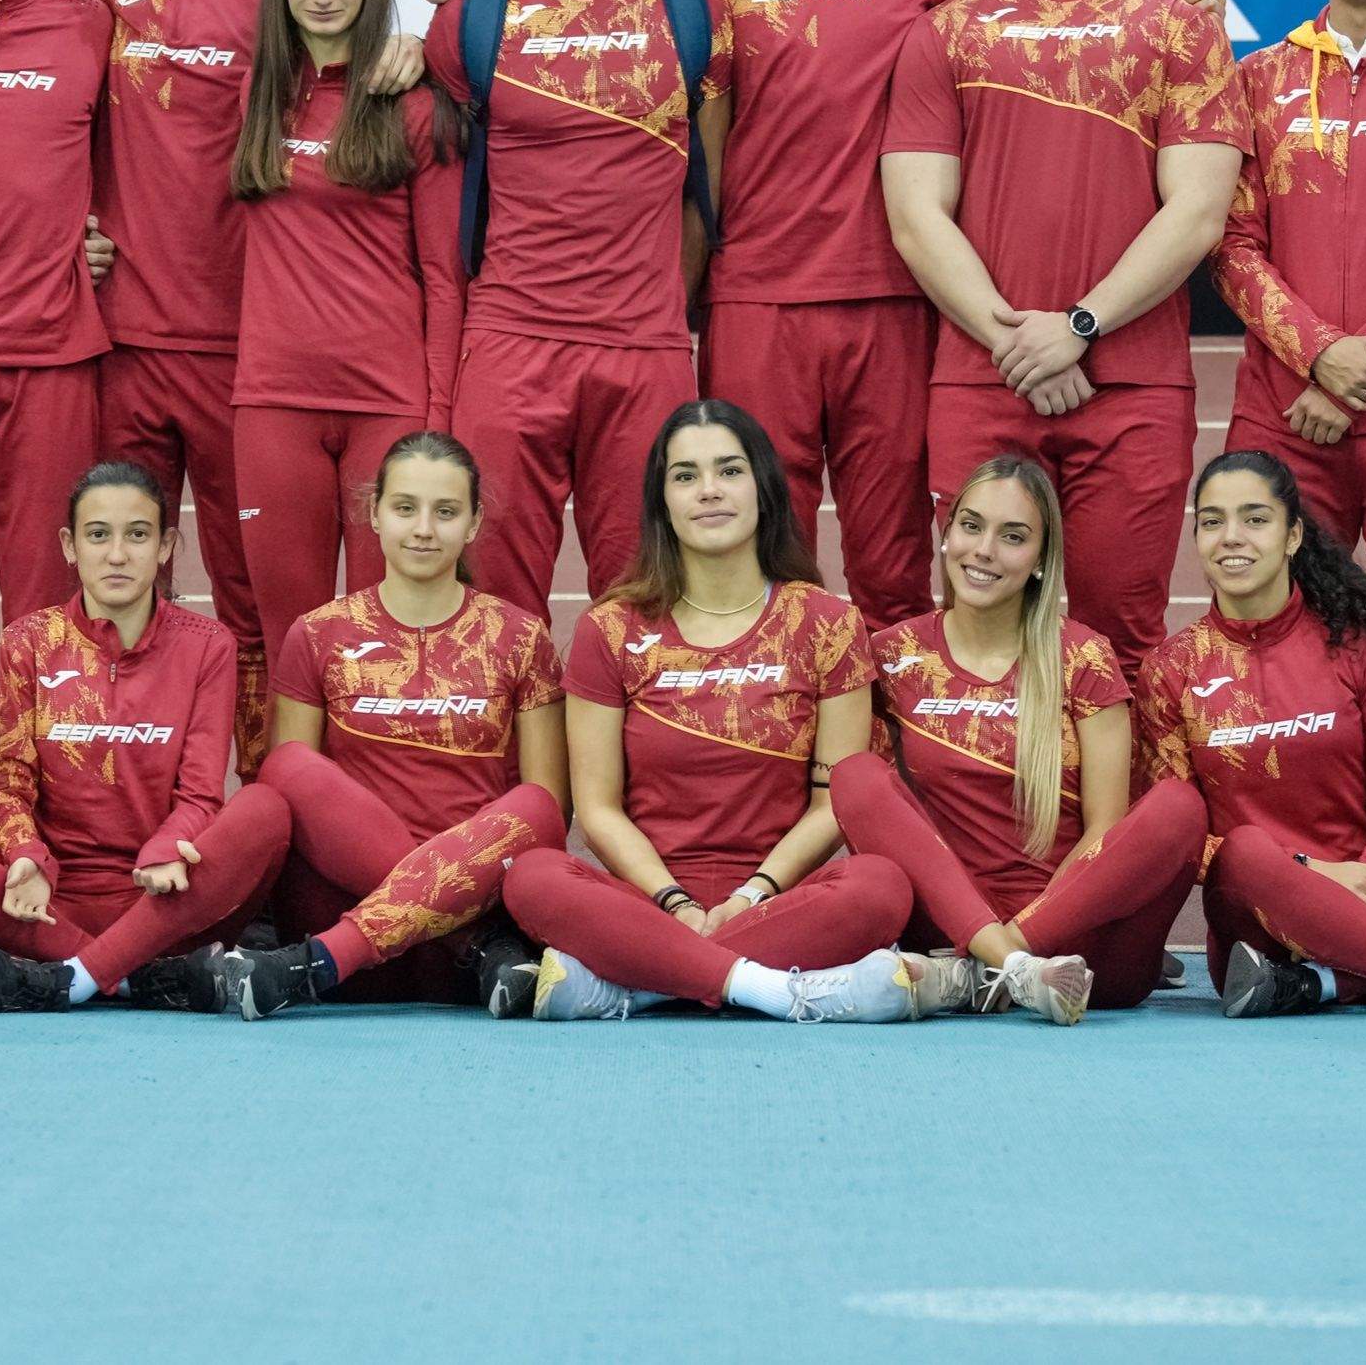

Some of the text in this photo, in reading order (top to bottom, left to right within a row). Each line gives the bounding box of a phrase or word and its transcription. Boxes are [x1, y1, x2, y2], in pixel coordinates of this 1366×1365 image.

[520, 32, 649, 55] ESPAÑA
[1001, 24, 1123, 41] ESPAÑA
[123, 41, 236, 67] ESPAÑA
[655, 662, 787, 689] ESPAÑA
[352, 694, 489, 716] ESPAÑA
[911, 697, 1019, 717] ESPAÑ
[47, 722, 174, 745] ESPAÑA
[1207, 712, 1335, 747] ESPAÑA
